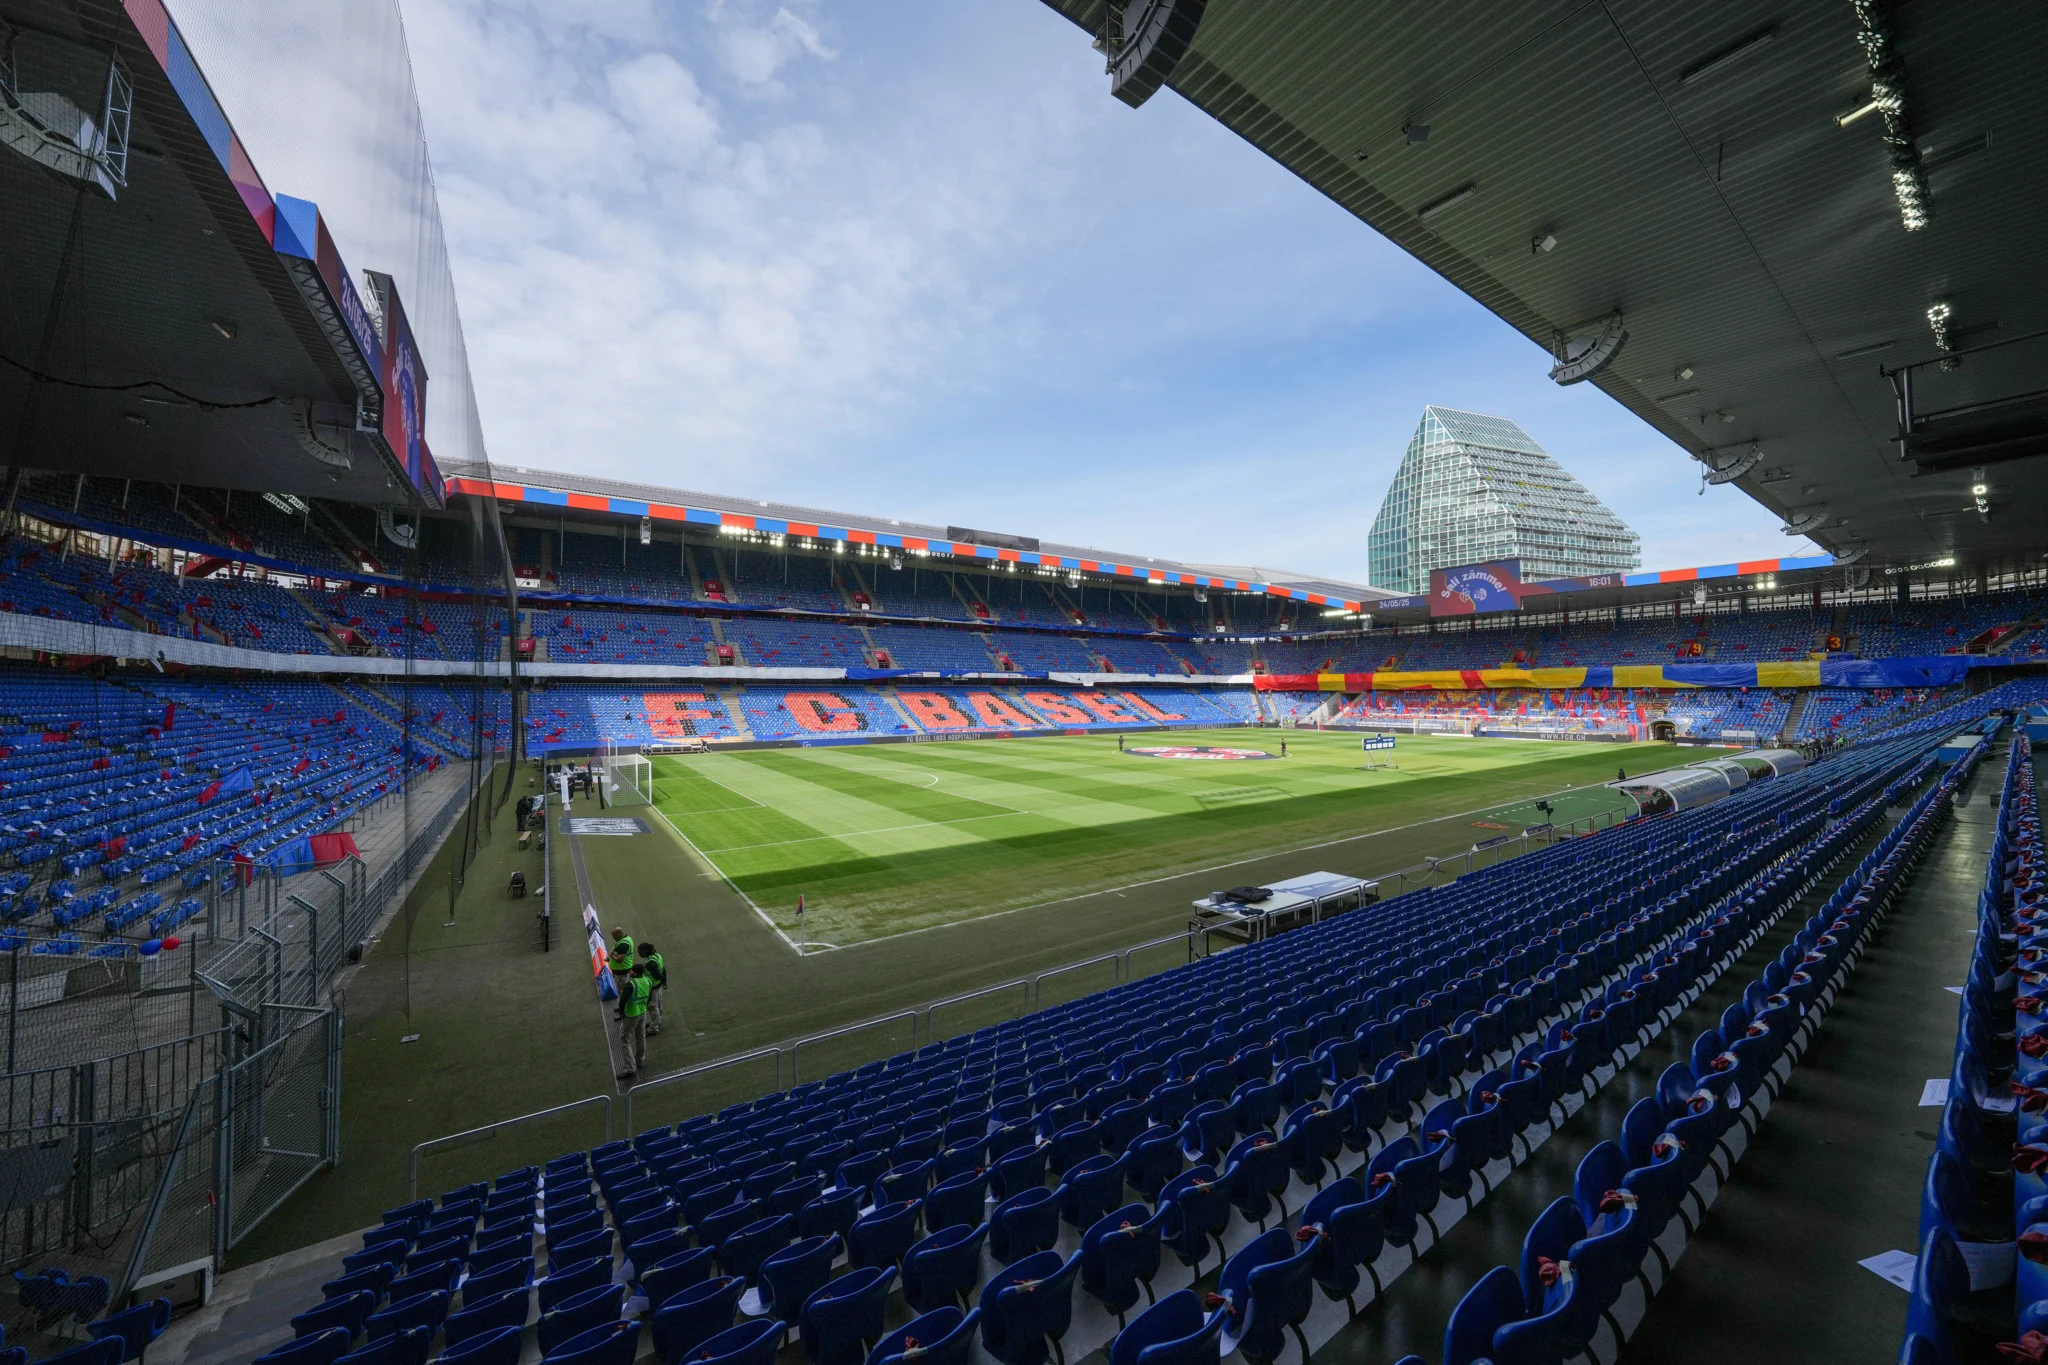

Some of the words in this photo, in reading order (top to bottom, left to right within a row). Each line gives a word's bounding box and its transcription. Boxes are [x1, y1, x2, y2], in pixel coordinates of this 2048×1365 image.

[1441, 576, 1460, 599] Sali
[1462, 569, 1508, 593] zämme!
[1589, 575, 1611, 587] 16:01
[1379, 598, 1410, 609] 24/05/25
[1693, 643, 1702, 653] 9
[1830, 637, 1841, 648] 3
[896, 691, 1190, 728] BASEL
[947, 733, 981, 741] HOSPITALITY
[1540, 733, 1586, 741] WWW.FCB.CH
